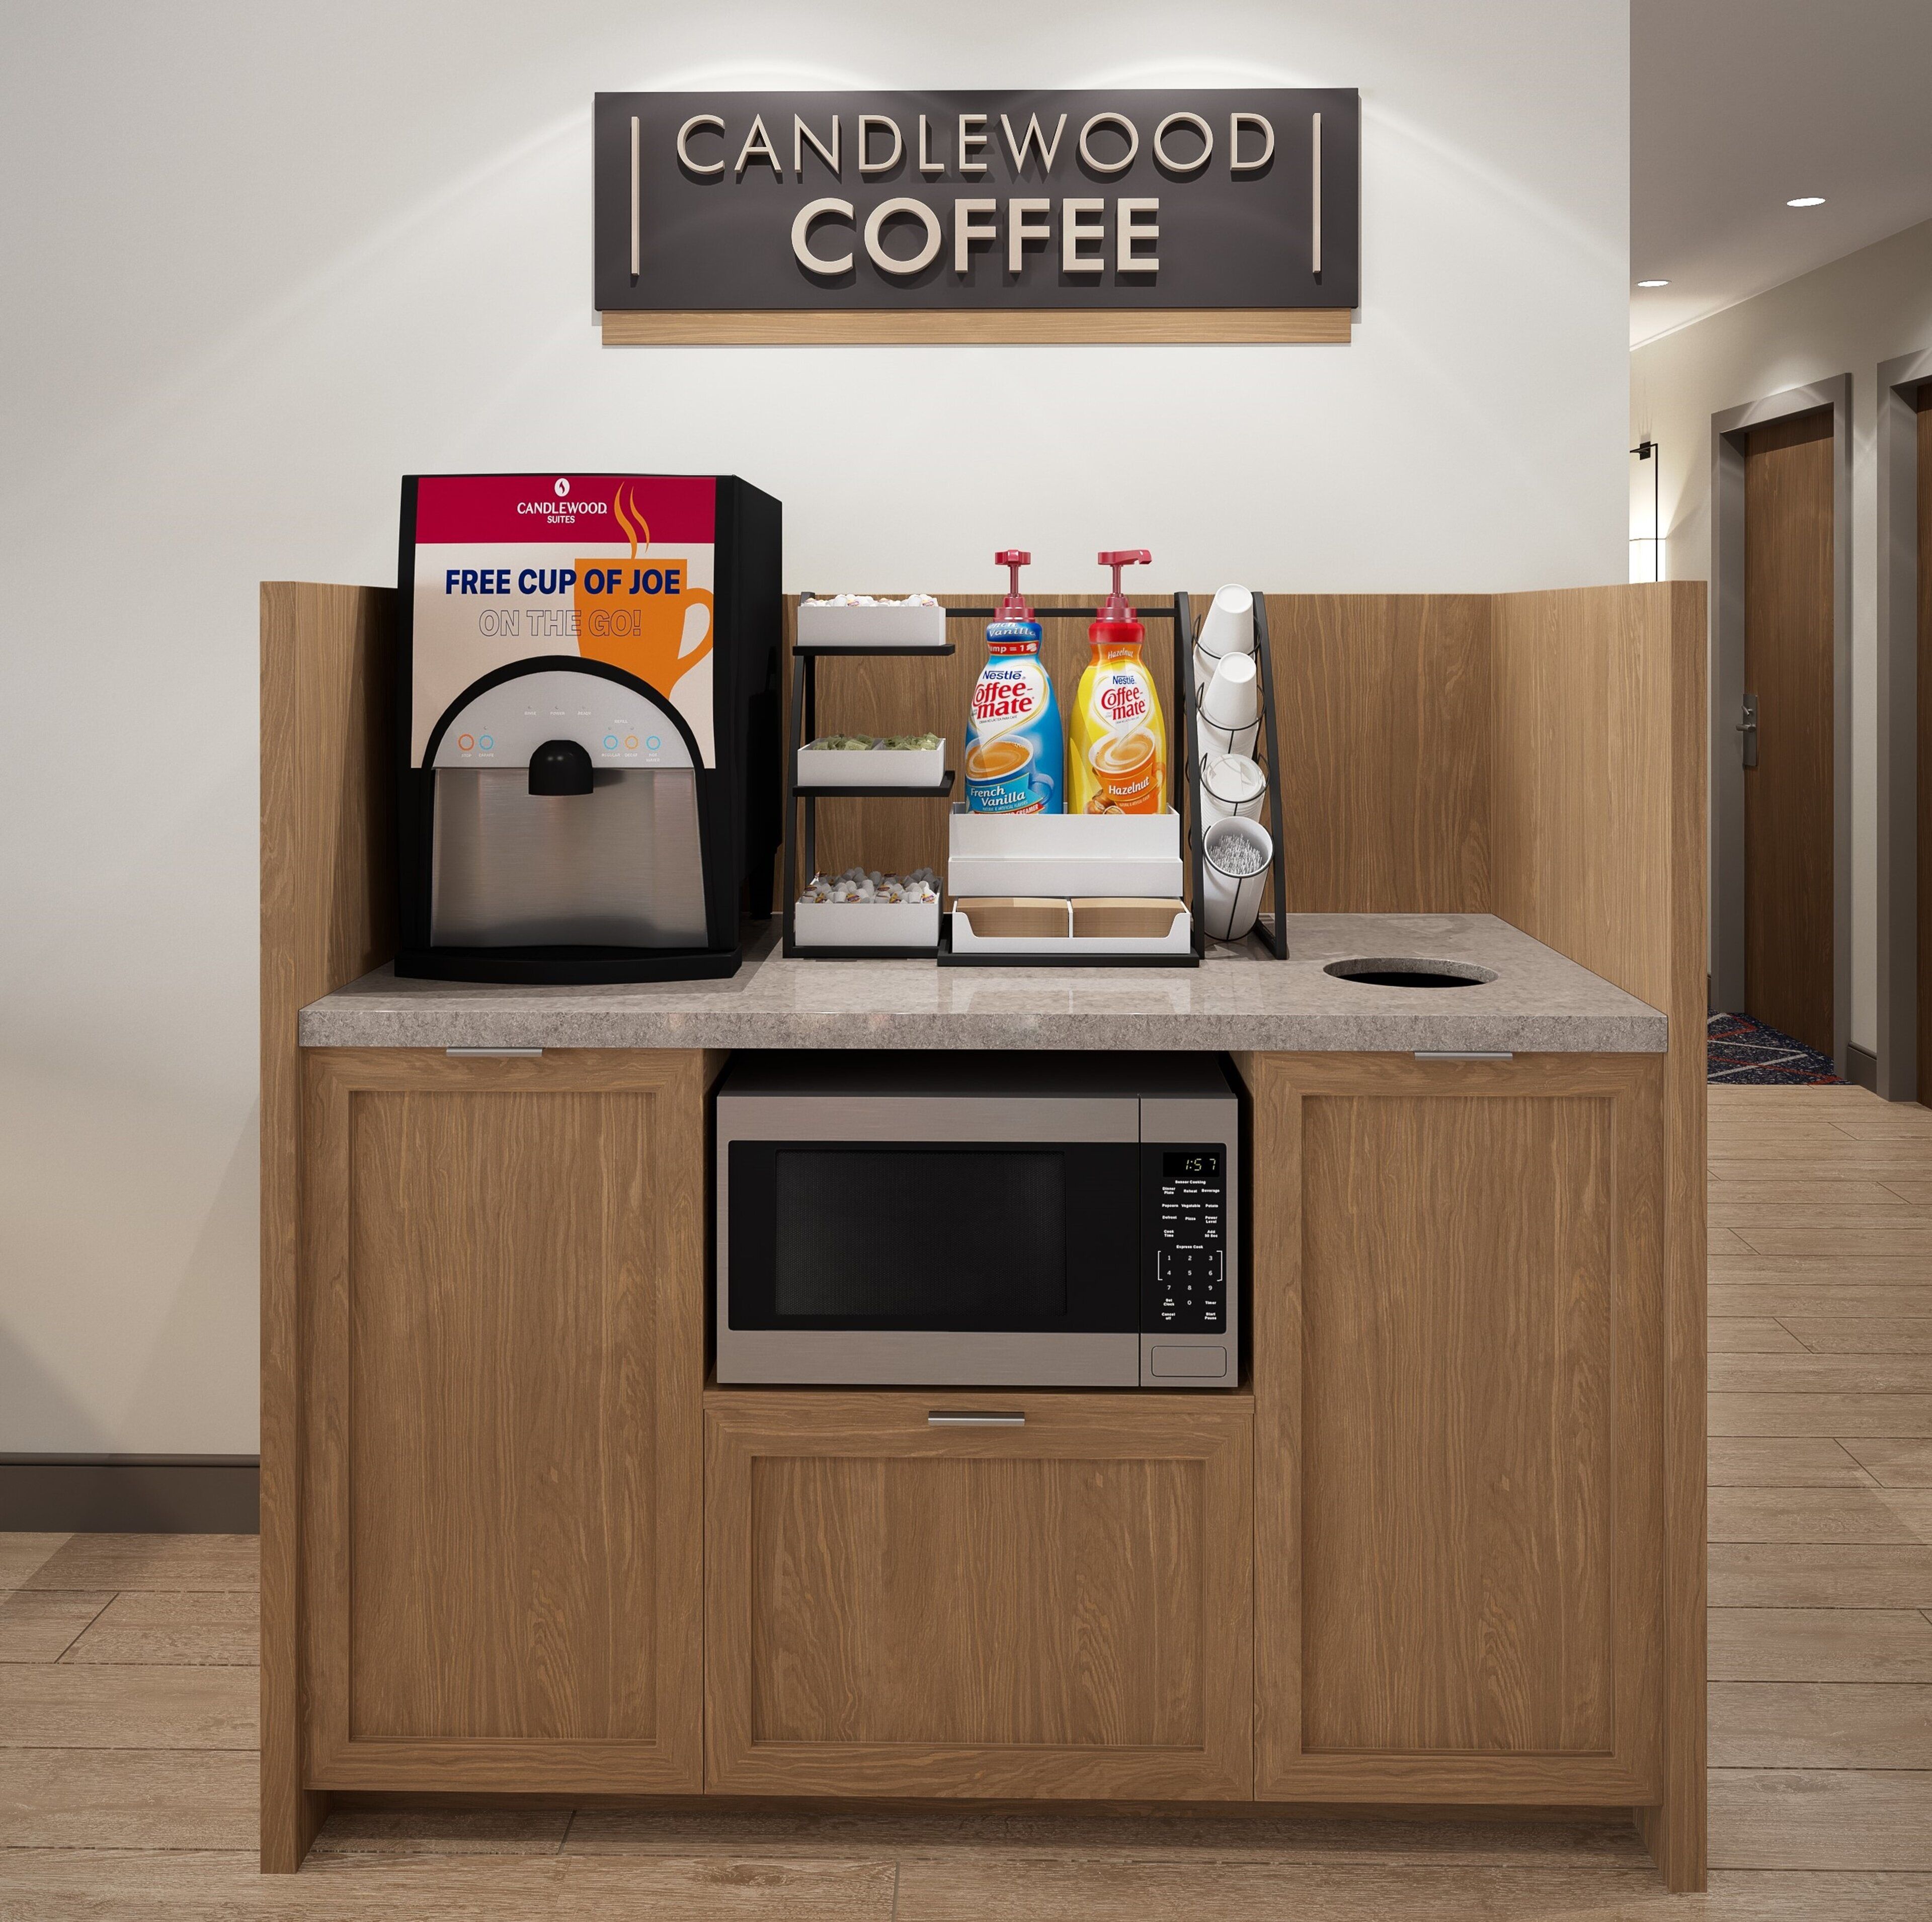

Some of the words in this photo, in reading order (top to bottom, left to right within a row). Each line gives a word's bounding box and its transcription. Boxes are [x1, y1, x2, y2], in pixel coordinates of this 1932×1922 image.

[677, 112, 1275, 174] CANDLEWOOD
[791, 197, 1160, 275] COFFEE
[517, 502, 607, 514] CANDLEWOOD
[446, 569, 511, 595] FREE
[518, 569, 577, 595] CUP
[584, 569, 622, 595] OF
[629, 569, 680, 595] JOE
[479, 610, 519, 636] ON
[526, 610, 582, 636] THE
[589, 610, 641, 636] GO!
[1108, 647, 1134, 659] Hazelnut
[977, 697, 1032, 719] mate
[1113, 701, 1146, 720] mate
[971, 786, 1005, 798] French
[1108, 776, 1150, 795] Hazelnut
[982, 791, 1025, 806] Vanilla
